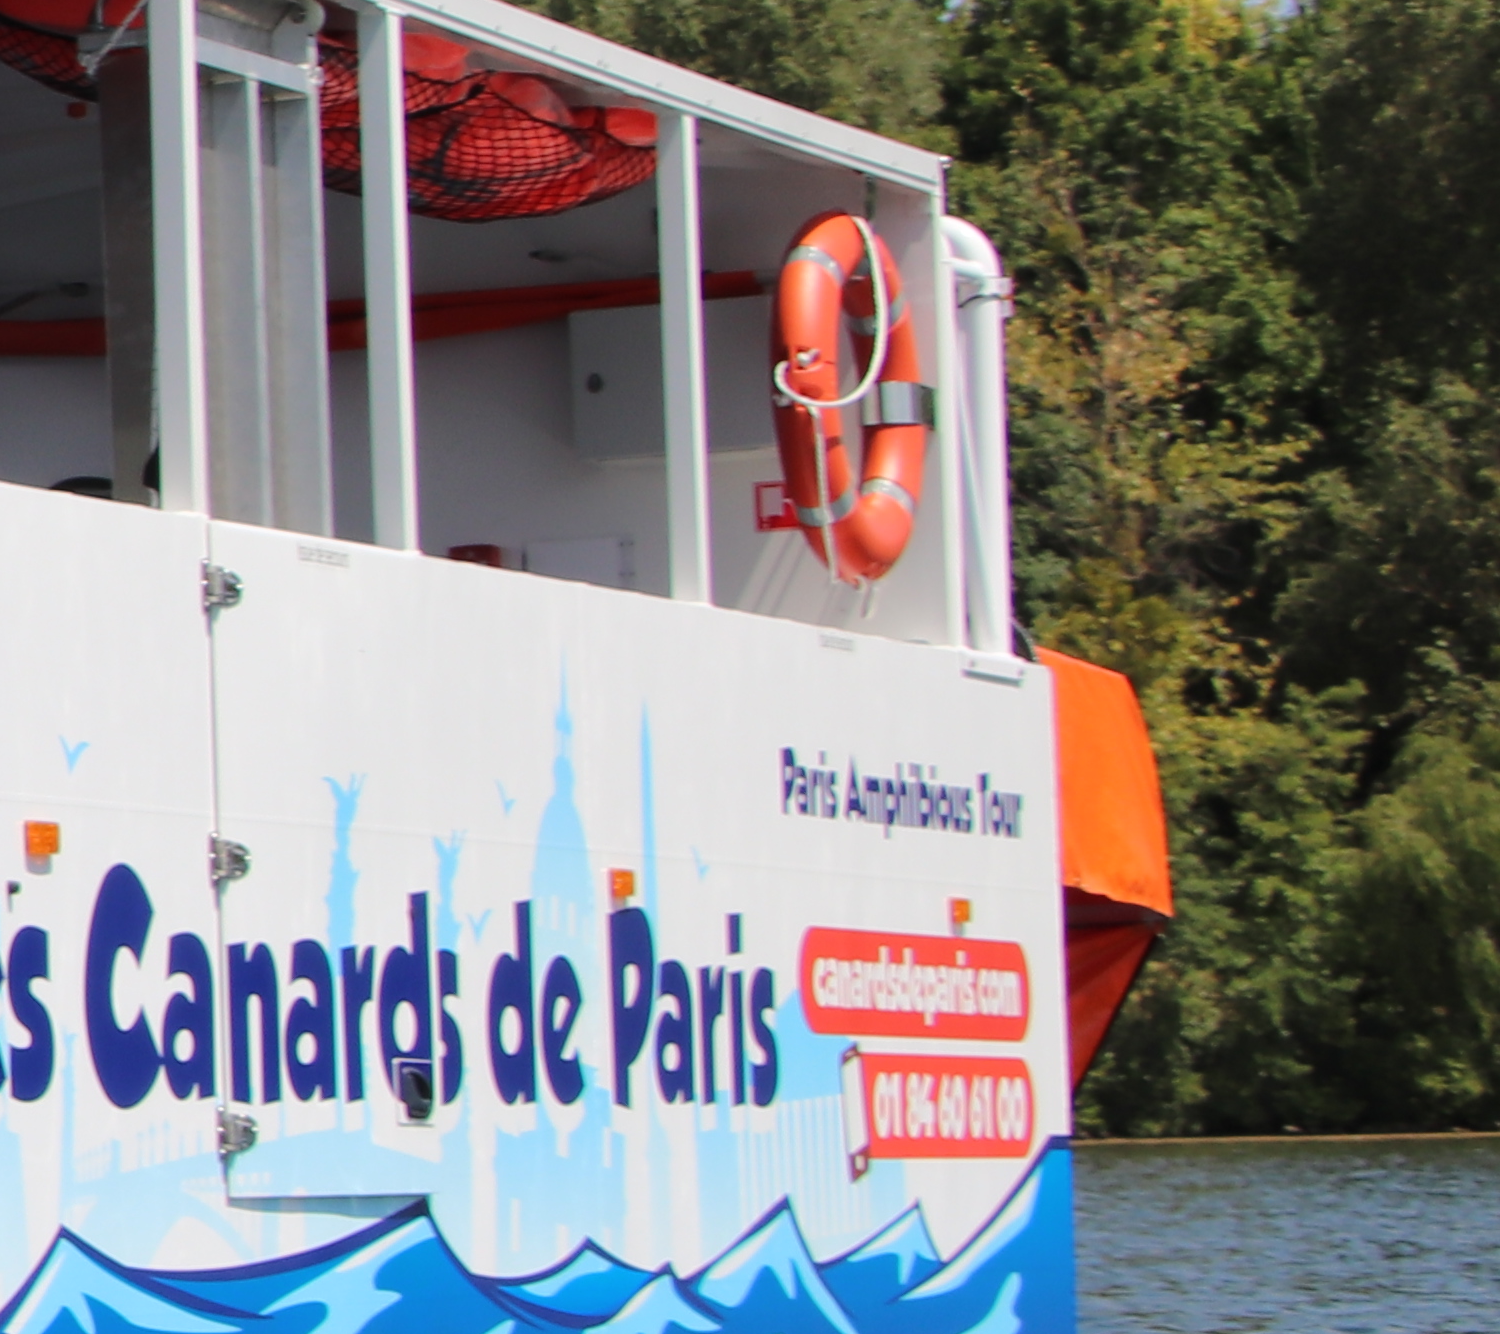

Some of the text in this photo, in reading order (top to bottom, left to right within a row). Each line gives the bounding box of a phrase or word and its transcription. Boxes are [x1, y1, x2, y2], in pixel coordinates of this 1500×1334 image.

[780, 746, 1023, 838] Paris Amphibious Tour
[85, 863, 464, 1109] Canards
[486, 900, 584, 1105] de
[607, 906, 779, 1109] Paris
